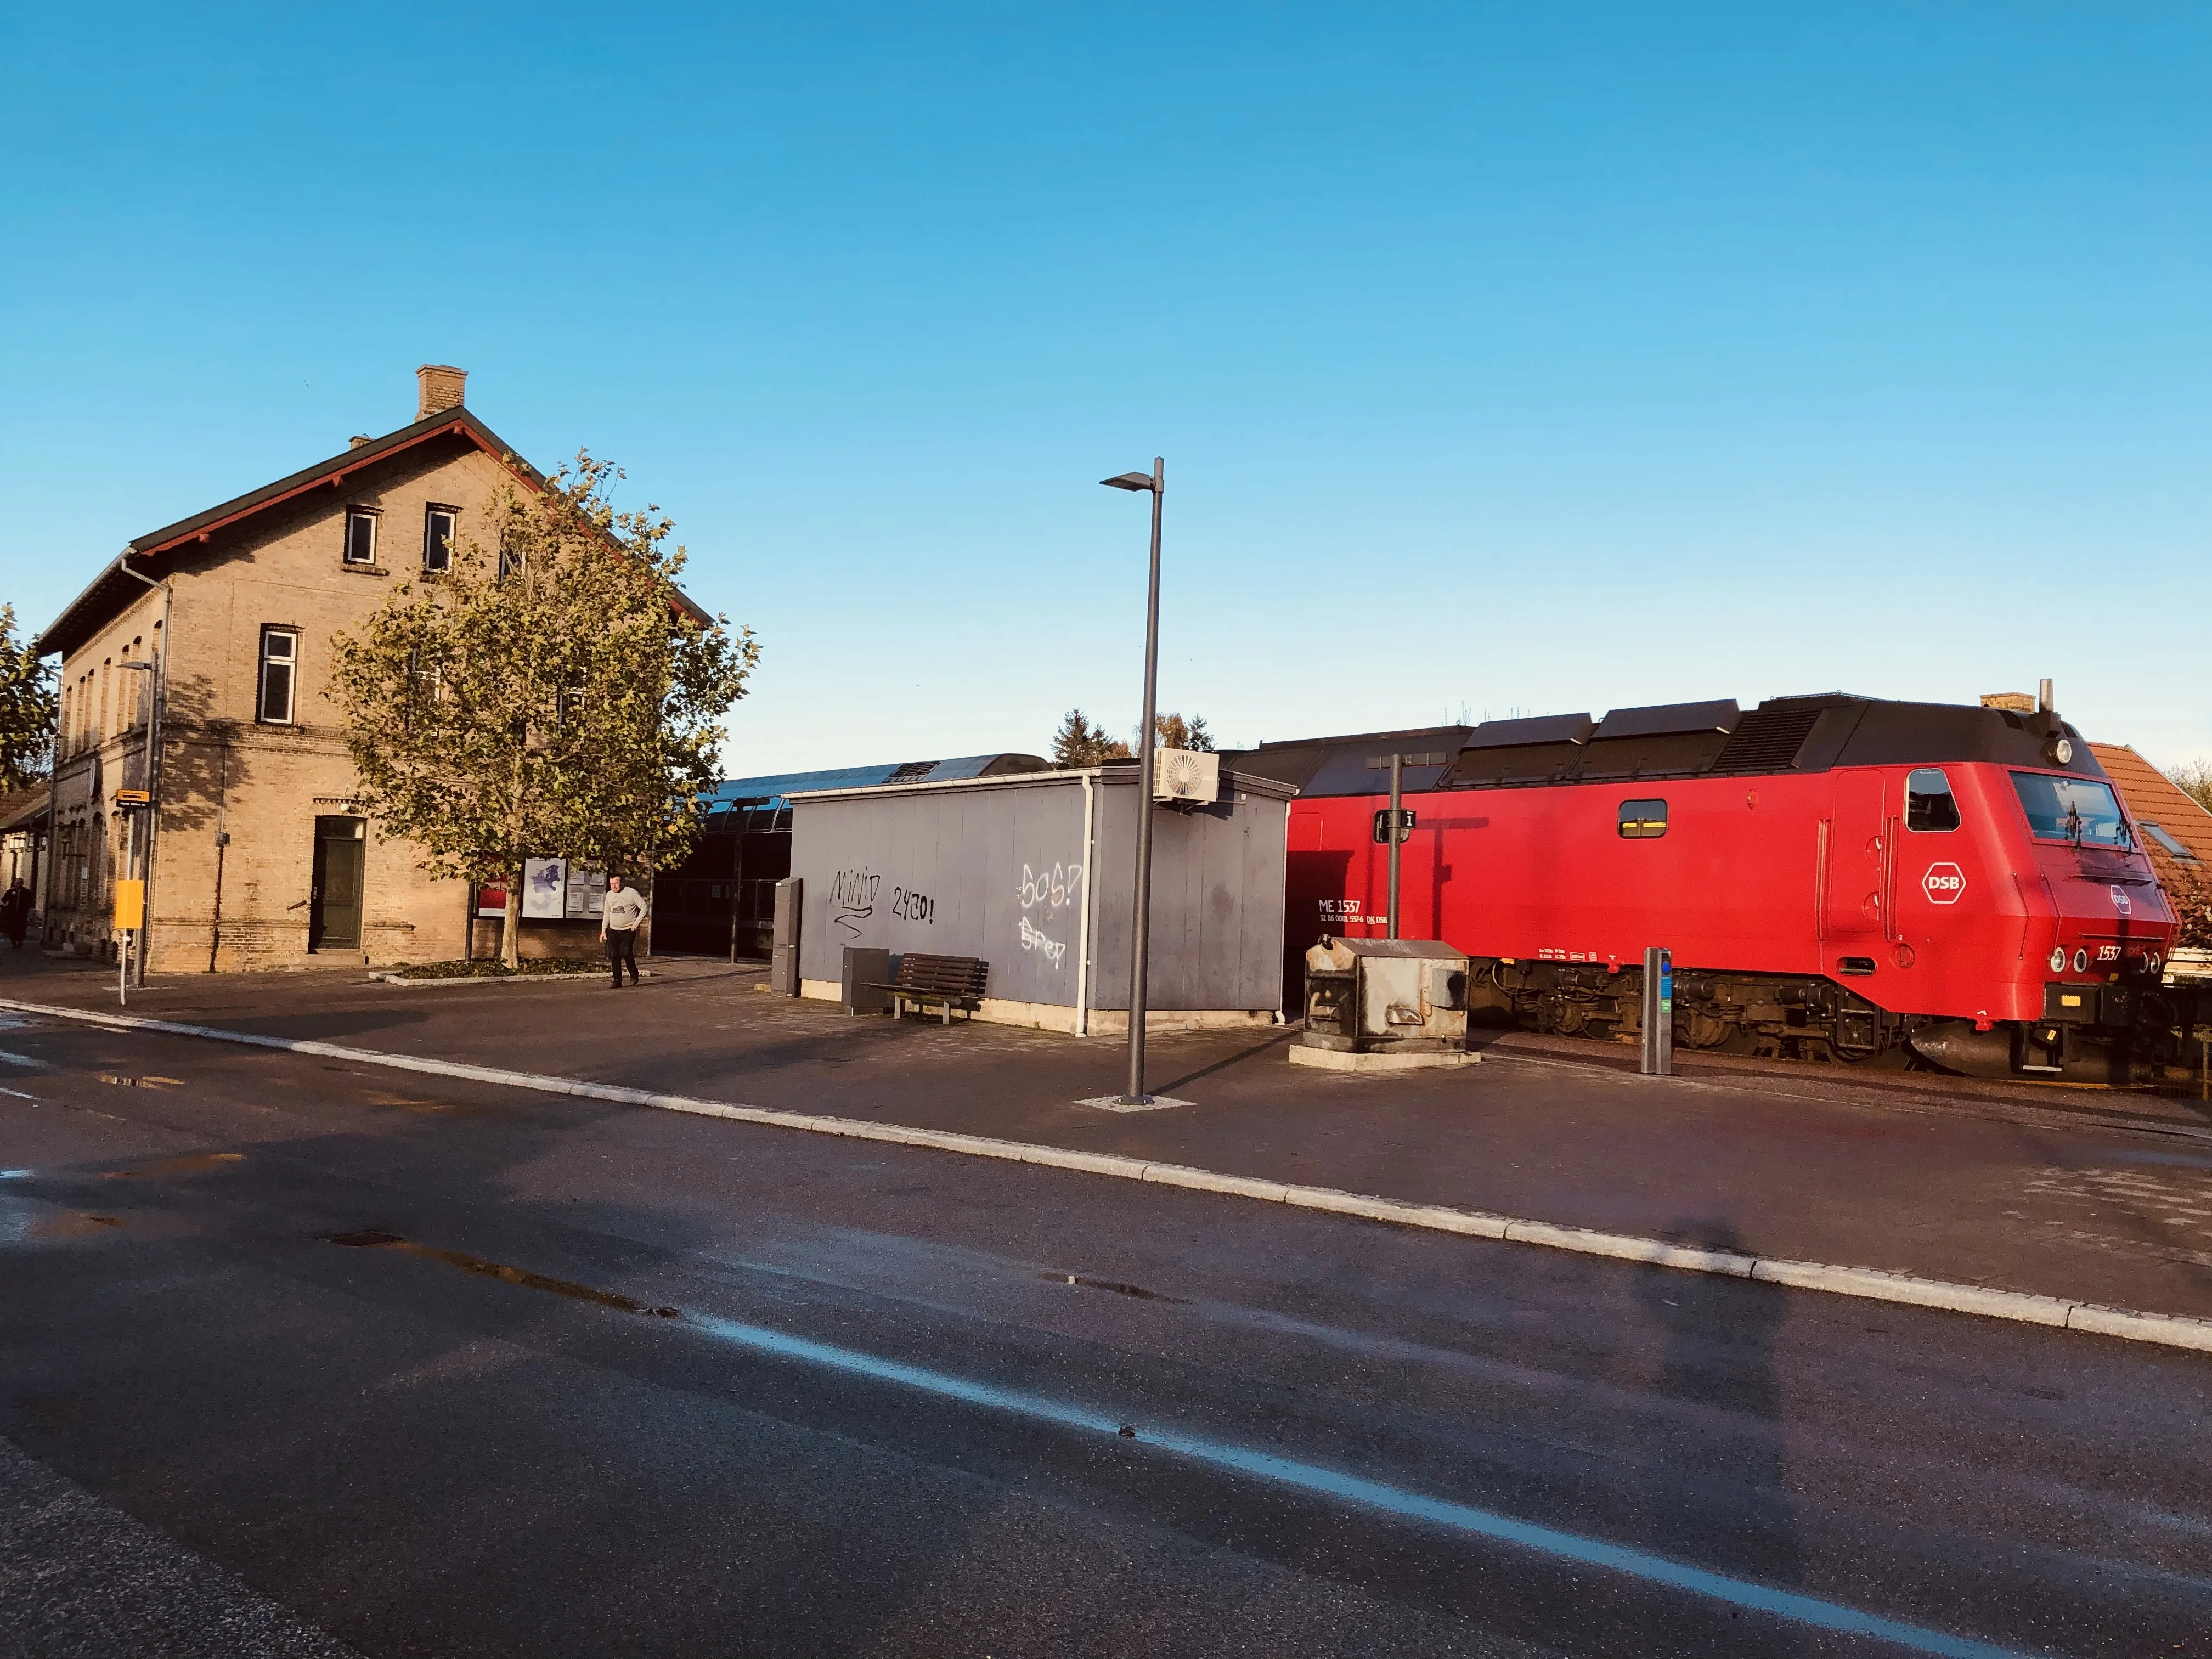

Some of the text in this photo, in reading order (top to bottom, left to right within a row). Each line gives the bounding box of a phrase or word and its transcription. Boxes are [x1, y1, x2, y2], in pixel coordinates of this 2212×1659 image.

[1406, 815, 1413, 826] 1
[1928, 876, 1960, 889] DSB
[2113, 895, 2128, 905] DSB
[1319, 900, 1361, 913] ME 1537
[1367, 916, 1375, 924] DK
[2097, 946, 2121, 961] 1537
